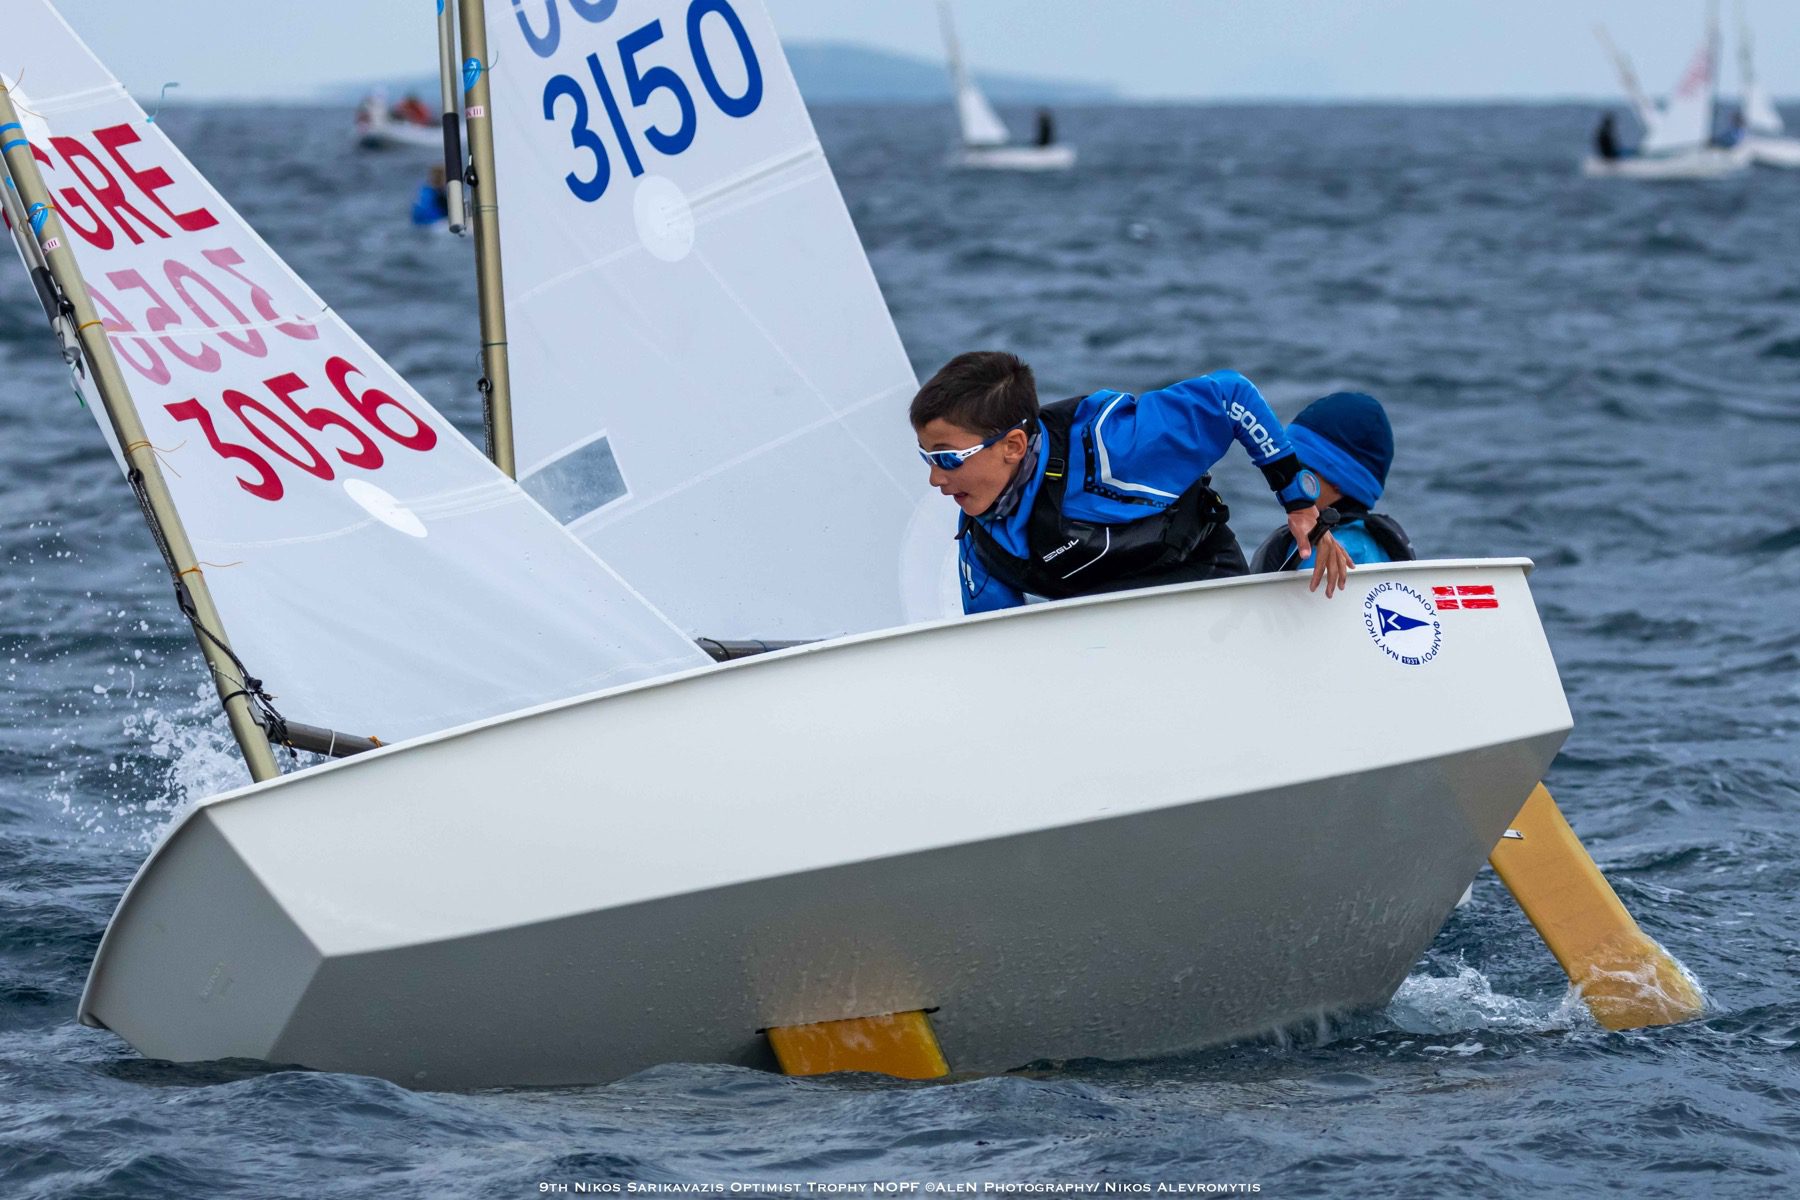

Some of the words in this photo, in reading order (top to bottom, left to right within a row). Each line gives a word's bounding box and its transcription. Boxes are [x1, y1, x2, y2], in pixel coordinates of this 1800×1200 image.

[542, 0, 764, 202] 3150
[28, 123, 219, 251] GRE
[164, 356, 438, 501] 3056
[1222, 400, 1280, 458] ROOS
[1364, 582, 1393, 610] ΟΜΙΛΟΣ
[1395, 582, 1437, 617] ΠΑΛΑΙΟΥ
[1363, 611, 1400, 661] ΝΑΥΤΙΚΟΣ
[1421, 620, 1442, 664] ΦΑΛΗΡΟΥ
